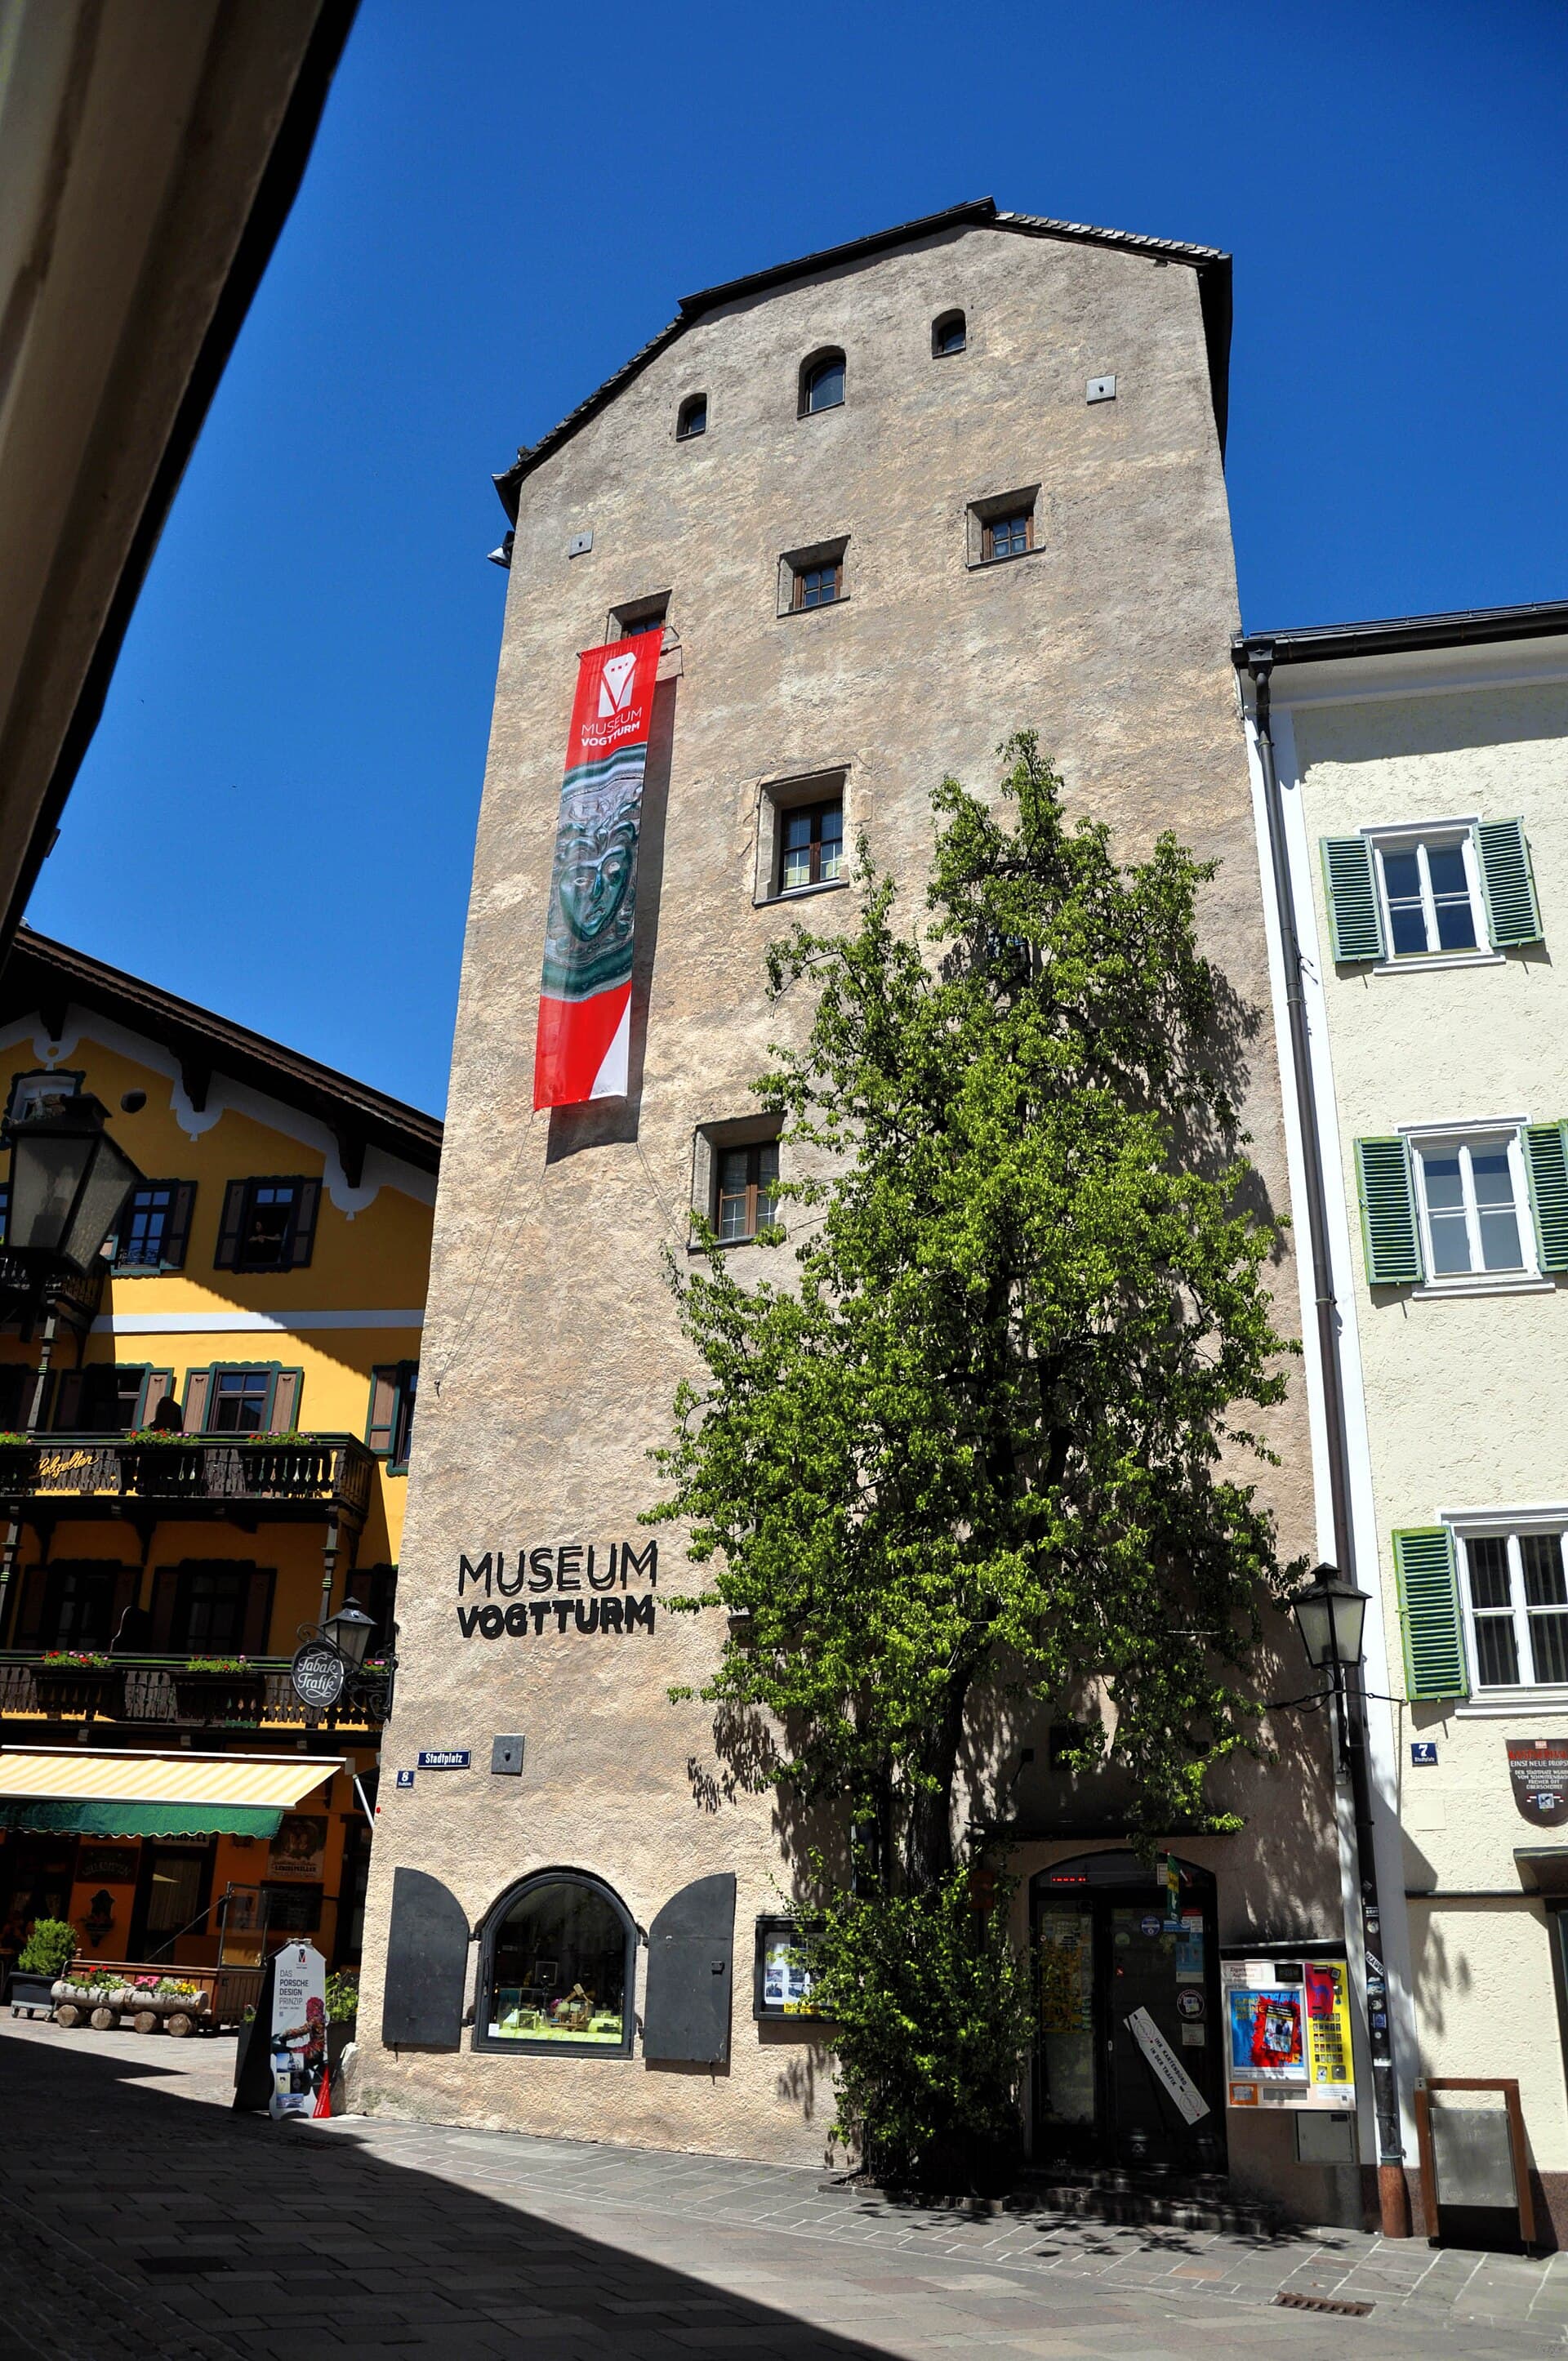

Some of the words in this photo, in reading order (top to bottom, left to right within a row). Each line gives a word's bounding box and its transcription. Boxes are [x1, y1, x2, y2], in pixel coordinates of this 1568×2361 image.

[581, 706, 642, 735] MUSEUM
[581, 720, 640, 746] VOGTTURM
[458, 1539, 658, 1597] MUSEUM
[457, 1594, 656, 1641] VOGTTURM
[297, 1651, 340, 1675] Tabak
[297, 1673, 337, 1695] Trafik
[1418, 1744, 1428, 1757] 7
[425, 1753, 463, 1766] Stadtplatz
[401, 1771, 409, 1782] 8
[279, 1969, 293, 1978] DAS
[279, 1979, 309, 1987] PORSCHE
[279, 1988, 302, 1996] DESIGN
[278, 1997, 303, 2006] PRINZIP
